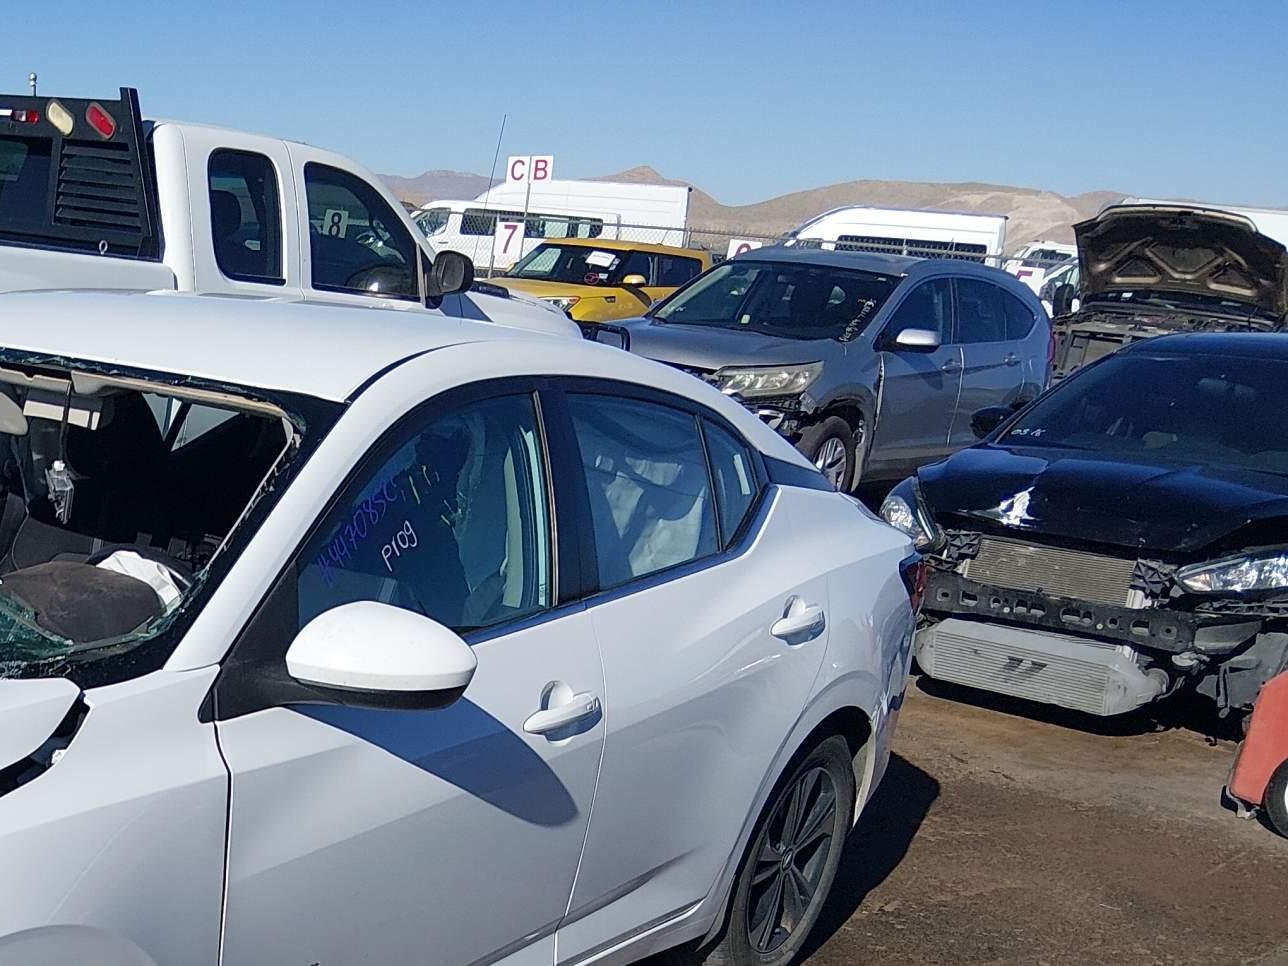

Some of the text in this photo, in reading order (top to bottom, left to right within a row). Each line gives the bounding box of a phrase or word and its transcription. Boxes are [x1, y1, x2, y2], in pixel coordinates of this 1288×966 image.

[510, 159, 549, 181] C B
[503, 223, 519, 254] 7
